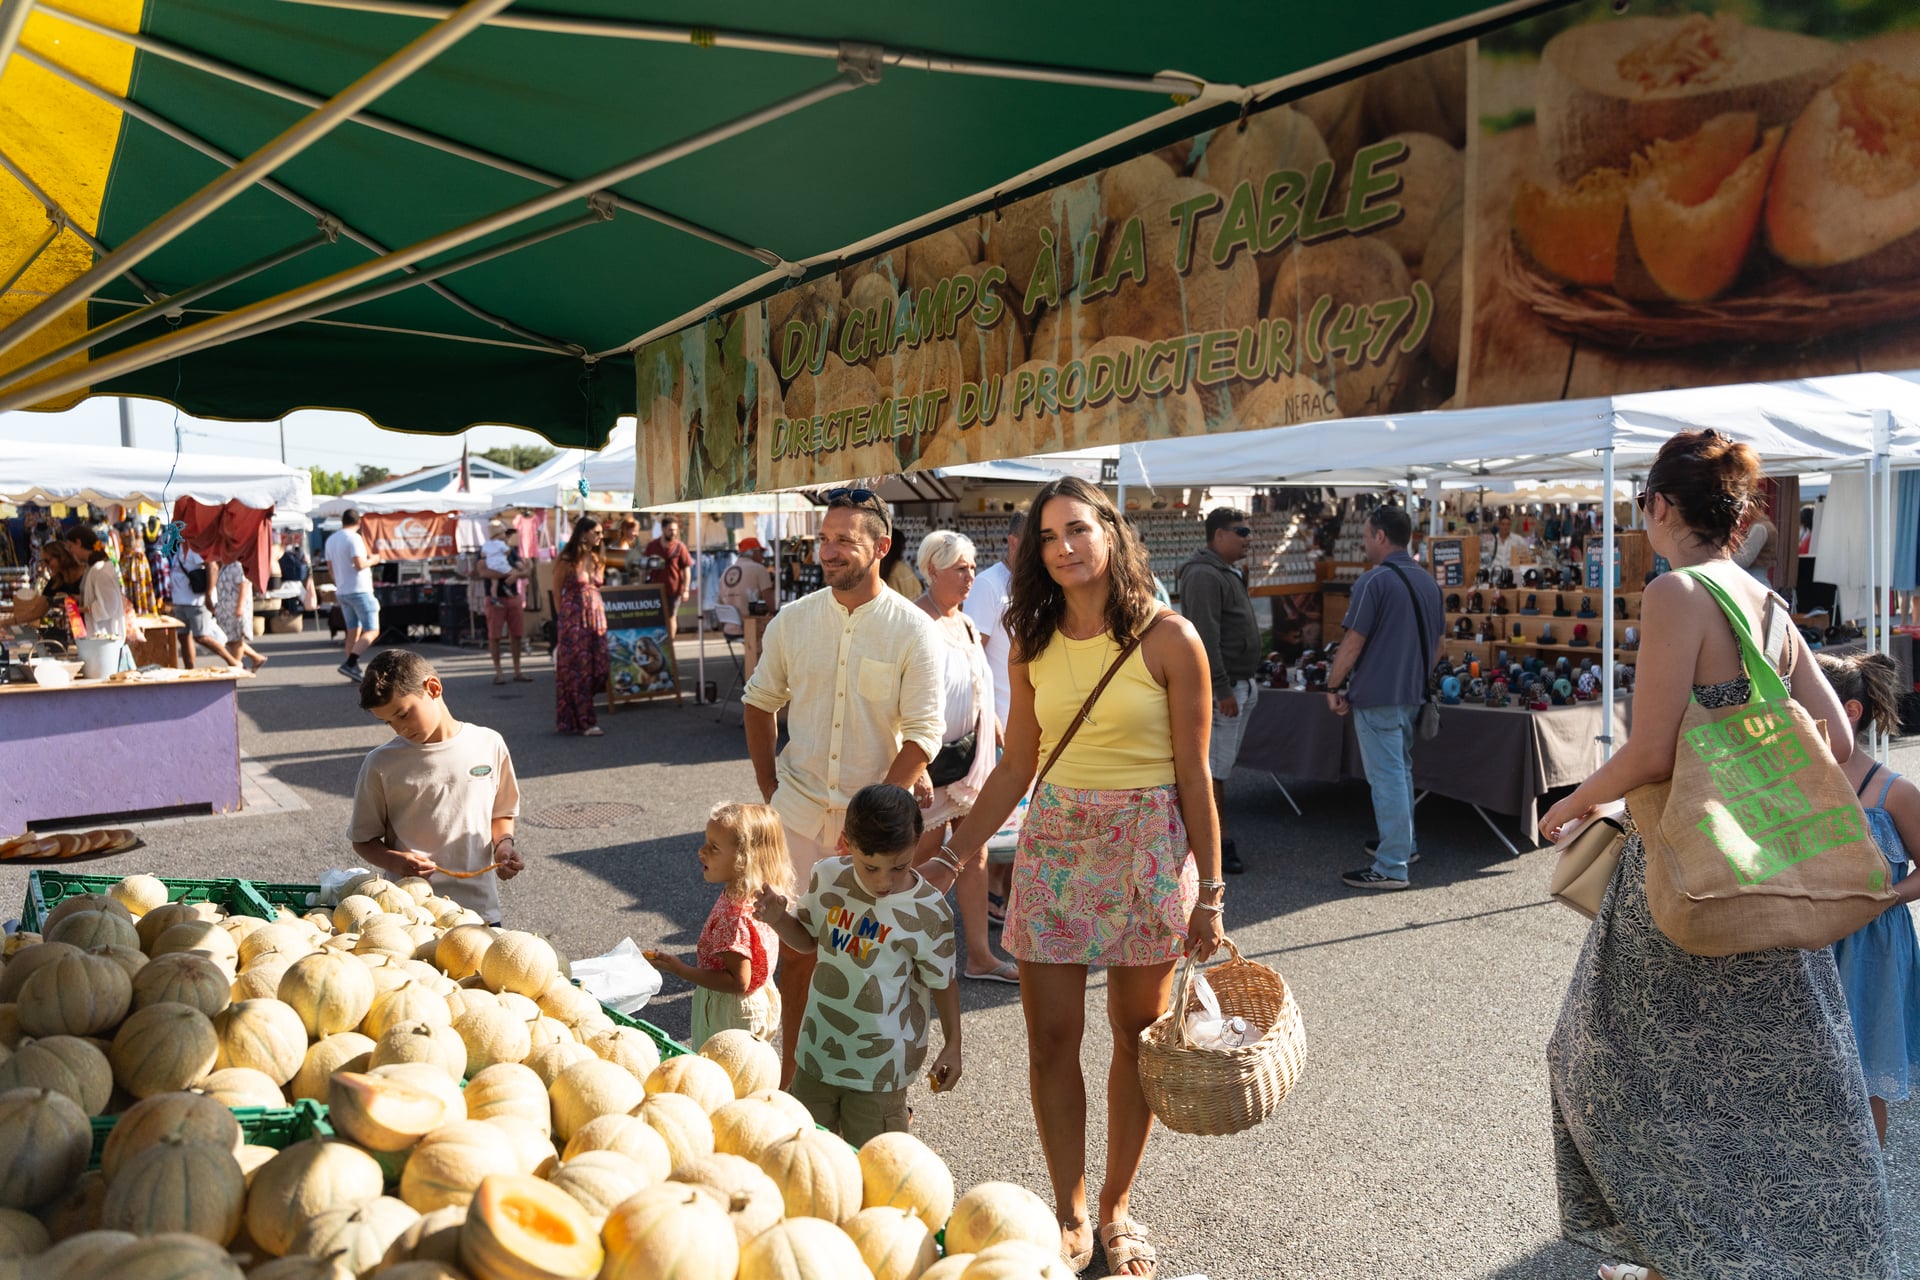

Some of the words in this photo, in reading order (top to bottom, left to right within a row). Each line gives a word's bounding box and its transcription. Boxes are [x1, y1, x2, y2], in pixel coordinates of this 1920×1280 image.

[780, 315, 831, 381] DU
[840, 265, 1008, 364] CHAMPS
[1022, 226, 1059, 315] À
[1078, 215, 1146, 300] LA
[1169, 138, 1408, 273] TABLE
[770, 388, 949, 461] DIRECTEMENT
[957, 373, 1003, 428] DU
[1012, 317, 1293, 418] PRODUCTEUR
[1306, 280, 1434, 366] (47)
[1284, 390, 1336, 424] NERAC
[1714, 703, 1786, 749] LOOK
[1746, 738, 1804, 779] TUE
[1758, 788, 1804, 822] PAS
[1761, 811, 1859, 864] TORTUES
[828, 905, 855, 931] ON
[858, 917, 893, 944] MY
[831, 927, 874, 960] WAY
